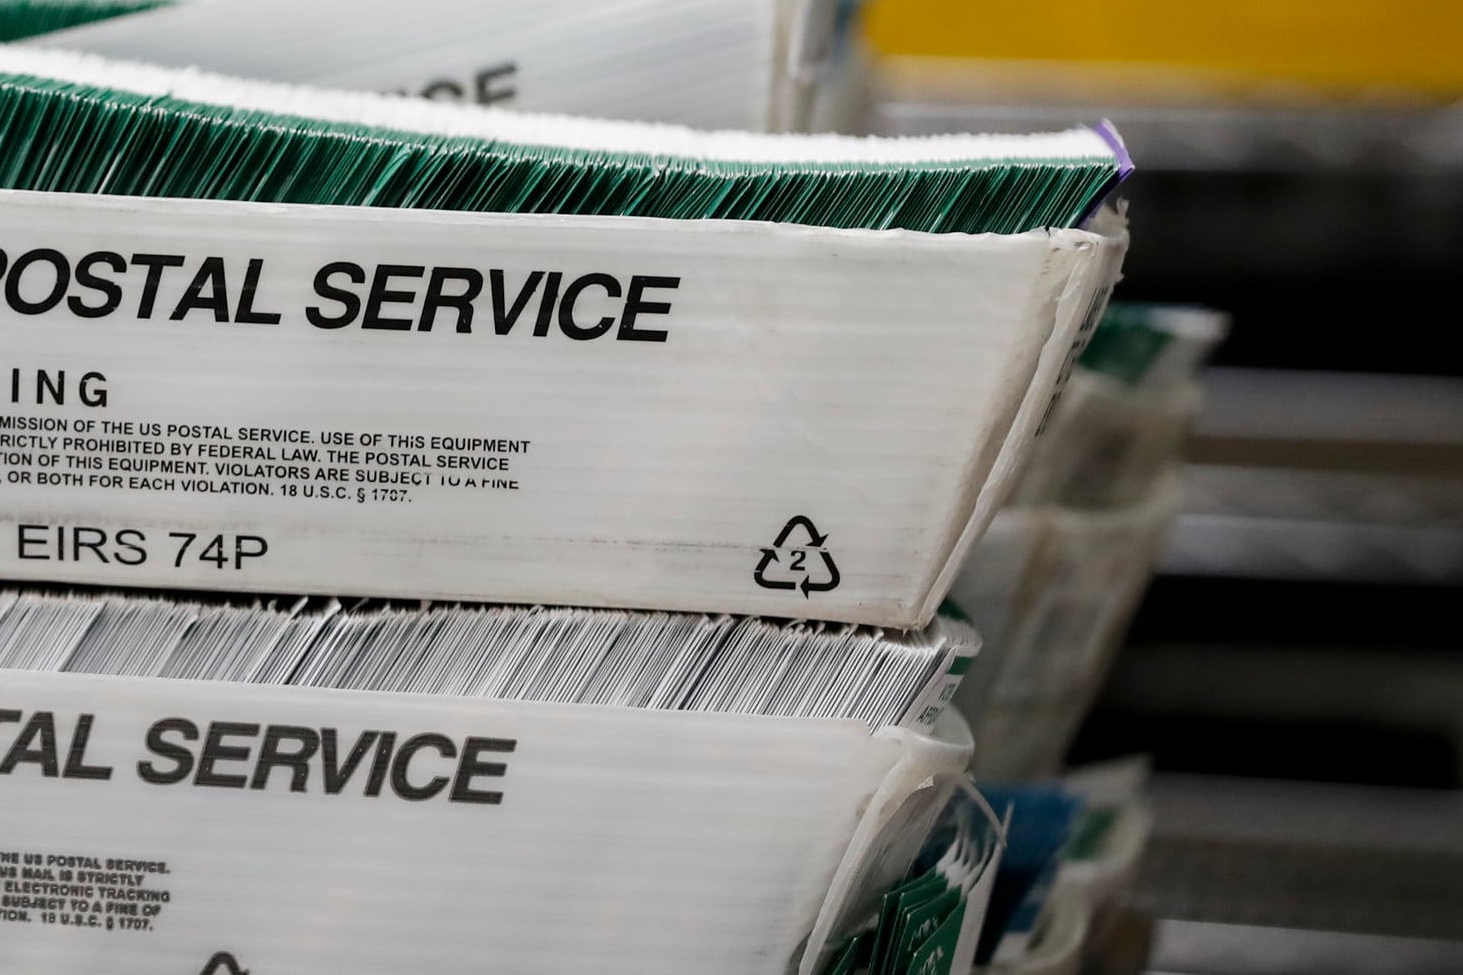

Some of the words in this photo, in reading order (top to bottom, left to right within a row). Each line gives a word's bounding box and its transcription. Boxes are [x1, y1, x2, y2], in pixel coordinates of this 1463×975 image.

[306, 262, 681, 342] SERVICE
[73, 420, 95, 433] OF
[101, 421, 133, 435] THE
[140, 423, 161, 436] US
[167, 424, 233, 440] POSTAL
[238, 428, 314, 444] SERVICE.
[321, 431, 354, 445] USE
[360, 433, 382, 447] OF
[388, 435, 425, 449] THIS
[431, 437, 531, 453] EQUIPMENT
[38, 454, 60, 467] OF
[65, 455, 102, 469] THIS
[109, 458, 209, 475] EQUIPMENT.
[215, 463, 310, 480] VIOLATORS
[314, 468, 349, 481] ARE
[355, 470, 431, 486] SUBJECT
[63, 437, 165, 455] PROHIBITED
[171, 443, 193, 456] BY
[198, 444, 276, 460] FEDERAL
[282, 448, 321, 462] LAW.
[327, 450, 359, 464] THE
[365, 452, 431, 467] POSTAL
[437, 455, 509, 471] SERVICE
[7, 471, 32, 484] OR
[37, 472, 83, 486] BOTH
[89, 475, 123, 488] FOR
[129, 477, 175, 491] EACH
[181, 480, 273, 495] VIOLATION.
[281, 484, 297, 497] 18
[303, 485, 351, 499] U.S.C.
[18, 524, 147, 565] EIRS
[169, 533, 267, 569] 74P
[790, 550, 806, 571] 2
[137, 718, 517, 804] SERVICE
[47, 855, 102, 870] POSTAL
[4, 880, 94, 898] ELECTRONIC
[97, 886, 171, 903] TRACKING
